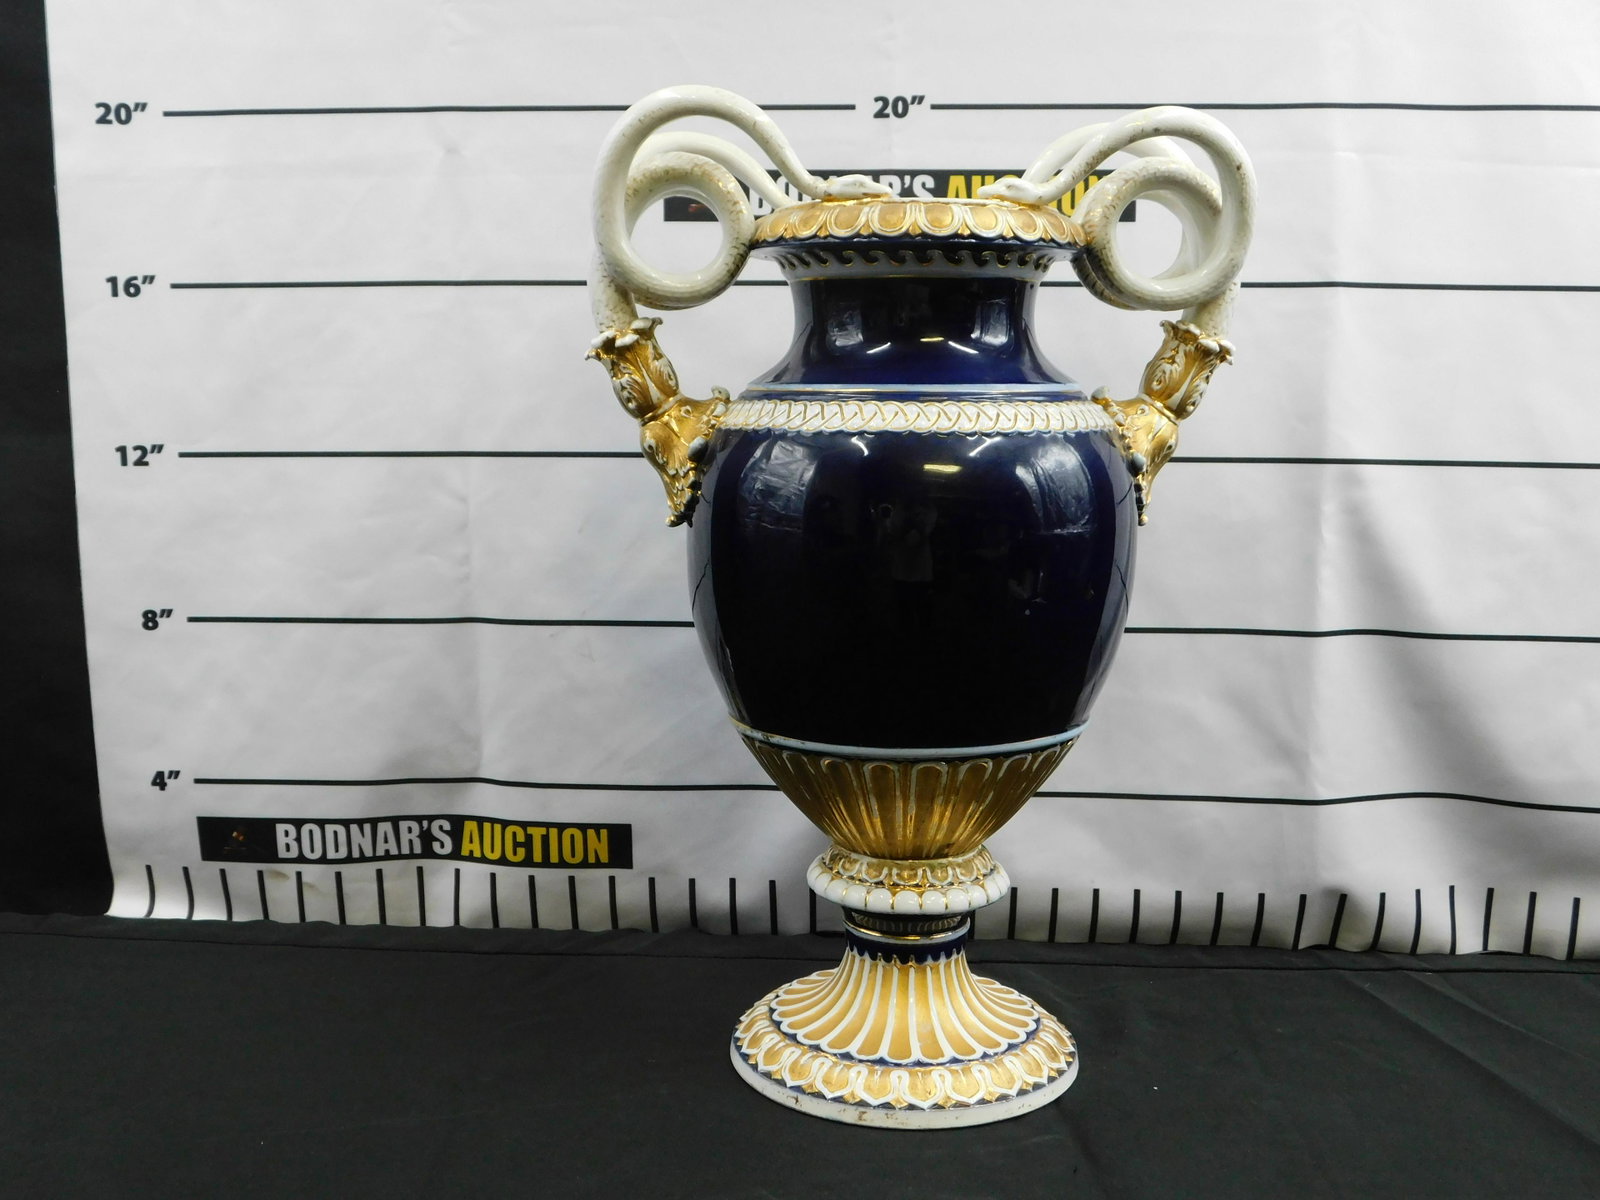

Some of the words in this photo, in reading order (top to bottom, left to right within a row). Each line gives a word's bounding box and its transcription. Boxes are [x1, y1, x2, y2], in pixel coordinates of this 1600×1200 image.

[95, 102, 149, 125] 20"
[873, 95, 926, 119] 20"
[106, 274, 157, 298] 16"
[115, 443, 165, 467] 12"
[141, 608, 174, 631] 8"
[150, 769, 181, 792] 4"
[275, 819, 453, 860] BODNAR'S
[460, 820, 609, 864] AUCTION
